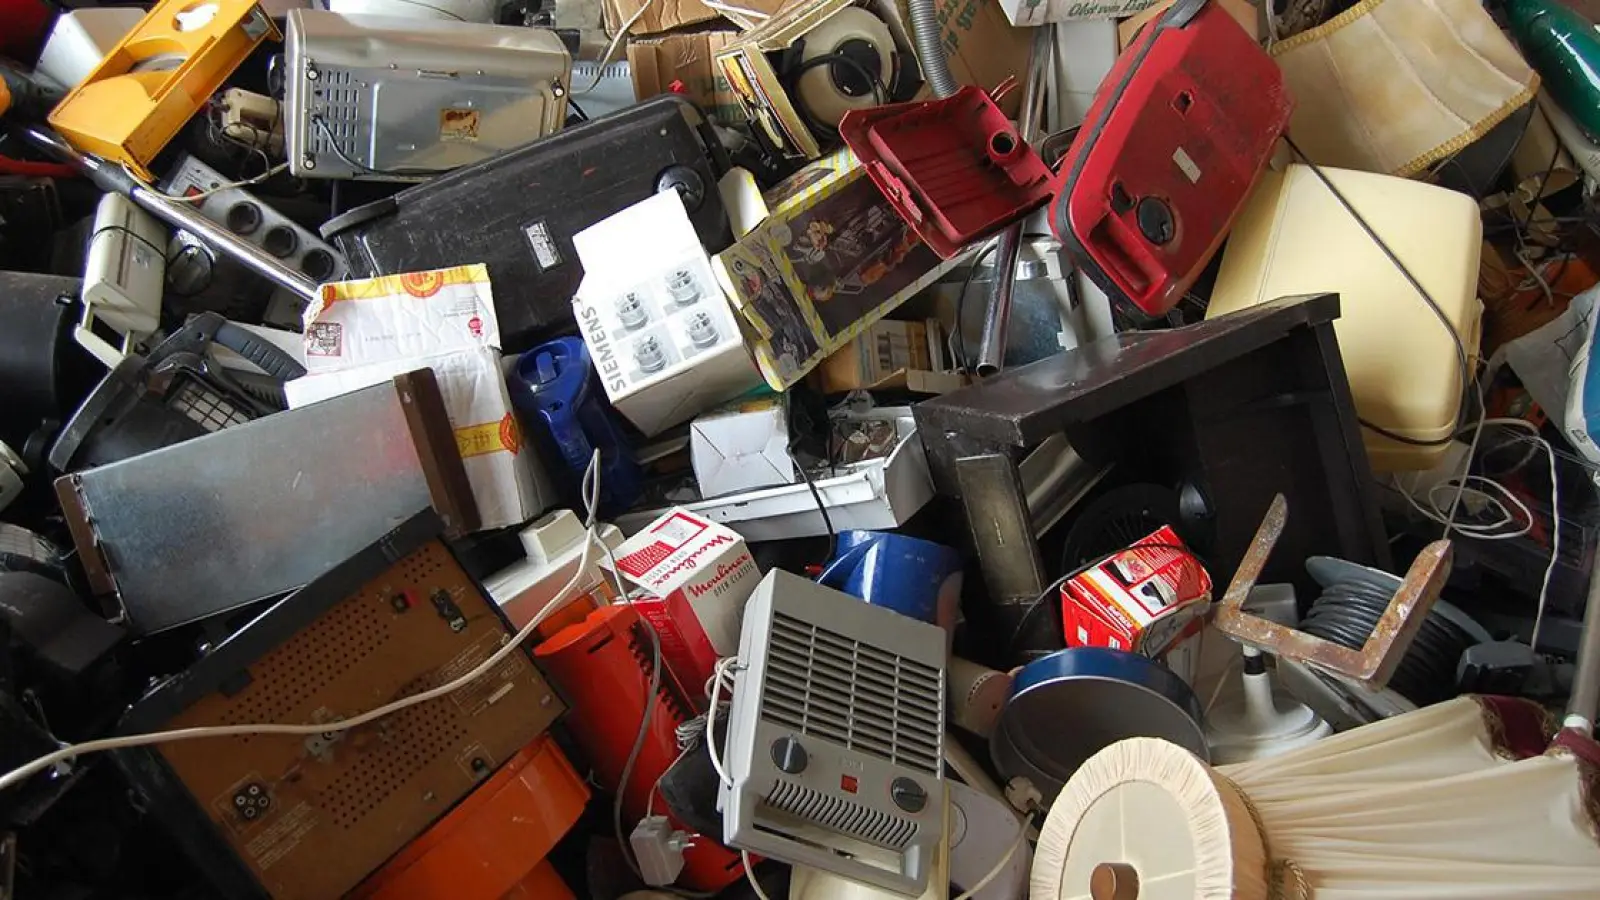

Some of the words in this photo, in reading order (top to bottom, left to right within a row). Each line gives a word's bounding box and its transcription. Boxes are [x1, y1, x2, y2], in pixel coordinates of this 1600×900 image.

[580, 306, 626, 393] SIEMENS
[651, 533, 733, 585] Moulinex
[687, 552, 749, 598] Moulinex
